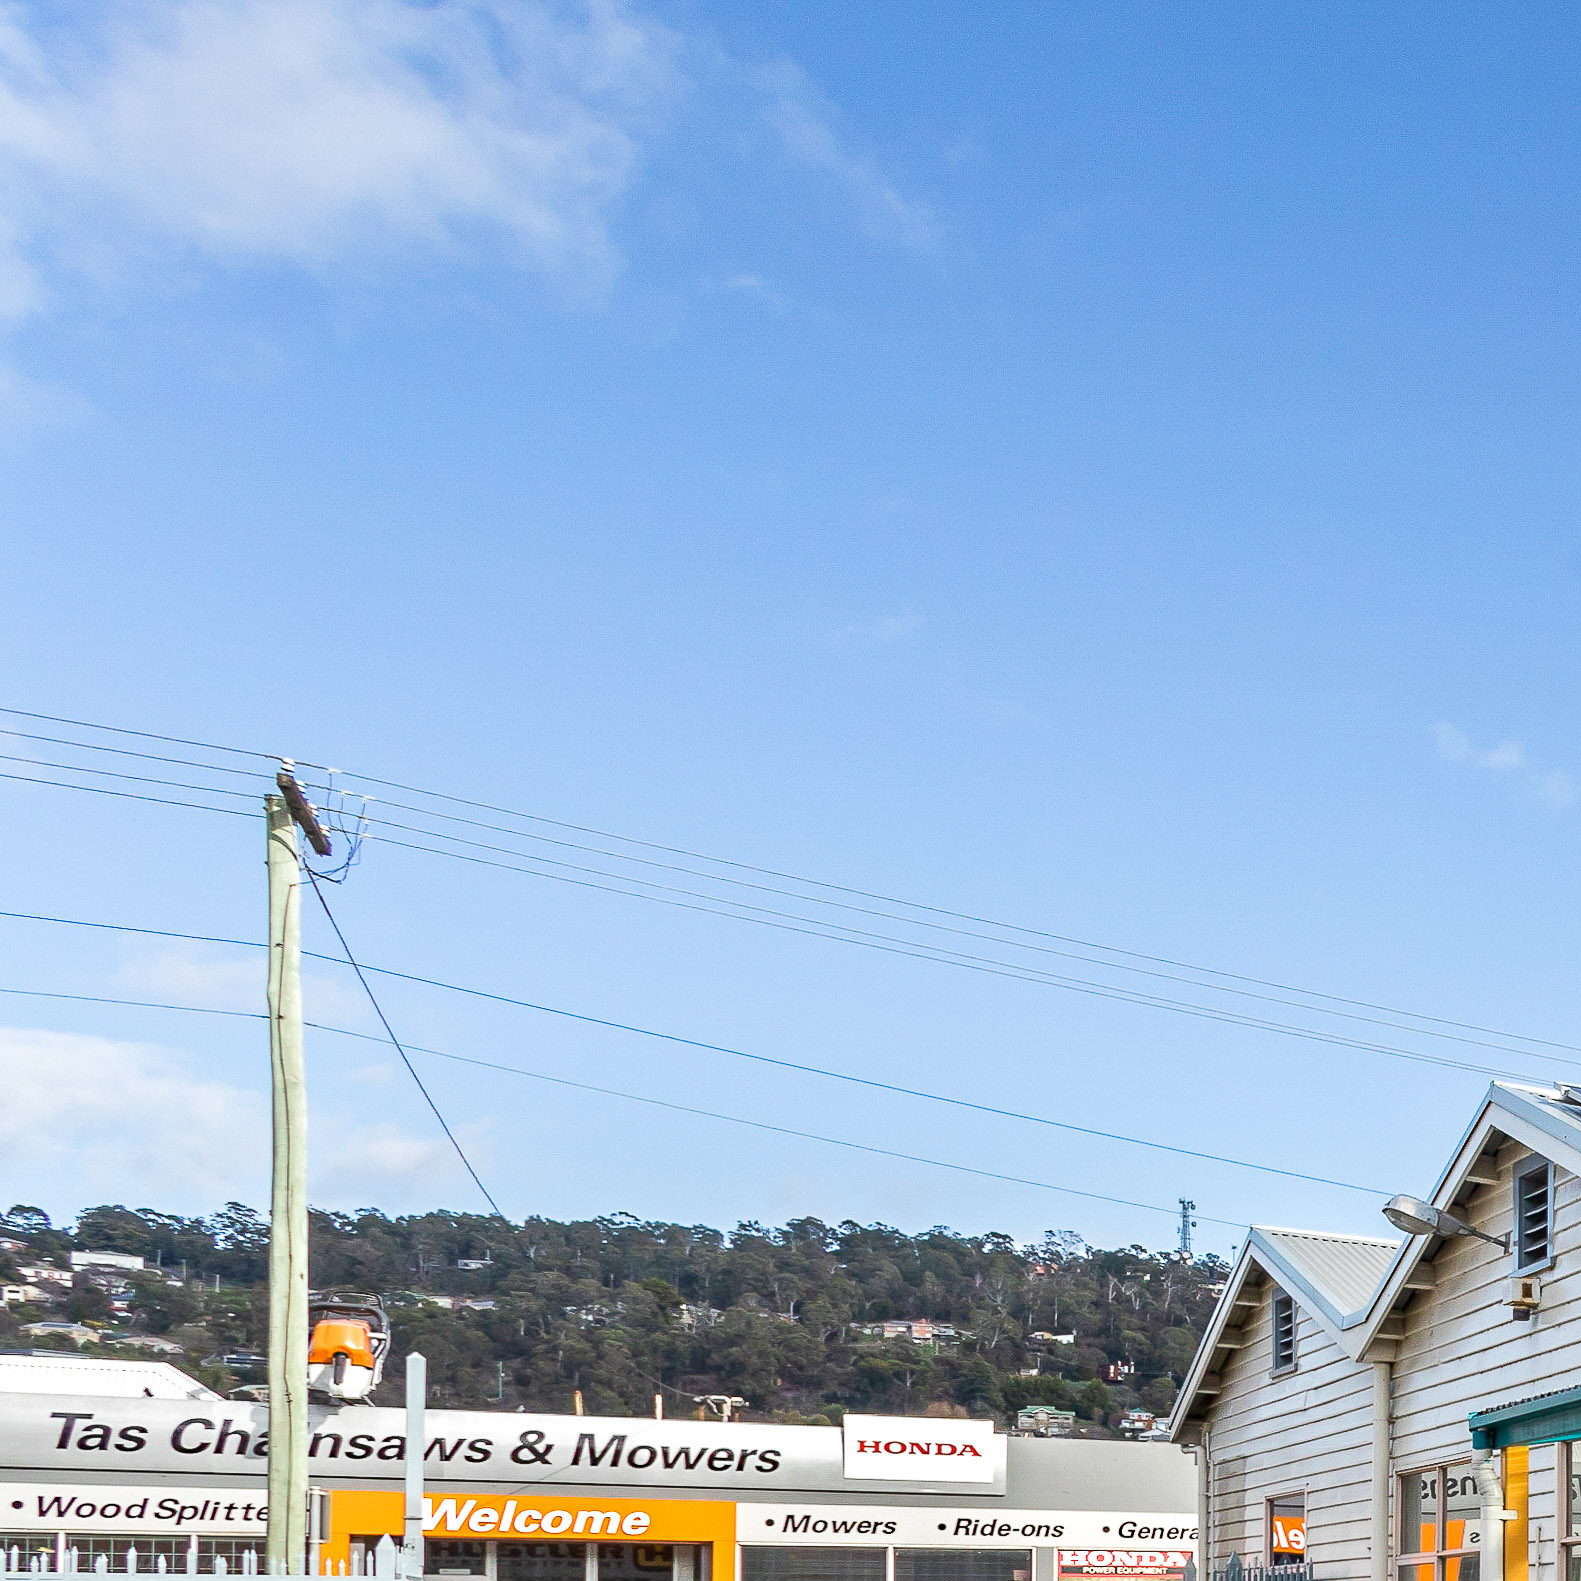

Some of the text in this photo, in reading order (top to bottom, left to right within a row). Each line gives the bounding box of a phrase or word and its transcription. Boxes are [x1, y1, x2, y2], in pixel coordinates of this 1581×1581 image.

[50, 1411, 783, 1474] Tas Chnsaws & Mowers
[856, 1439, 982, 1458] HONDA
[36, 1495, 269, 1526] Wood Splitte
[421, 1496, 651, 1537] Welcome
[781, 1513, 898, 1536] Mowers
[953, 1516, 1065, 1539] Ride-ons
[1118, 1520, 1199, 1540] Genera
[1059, 1551, 1188, 1568] HONDA
[1082, 1566, 1169, 1576] POWER EQUIPMENT
